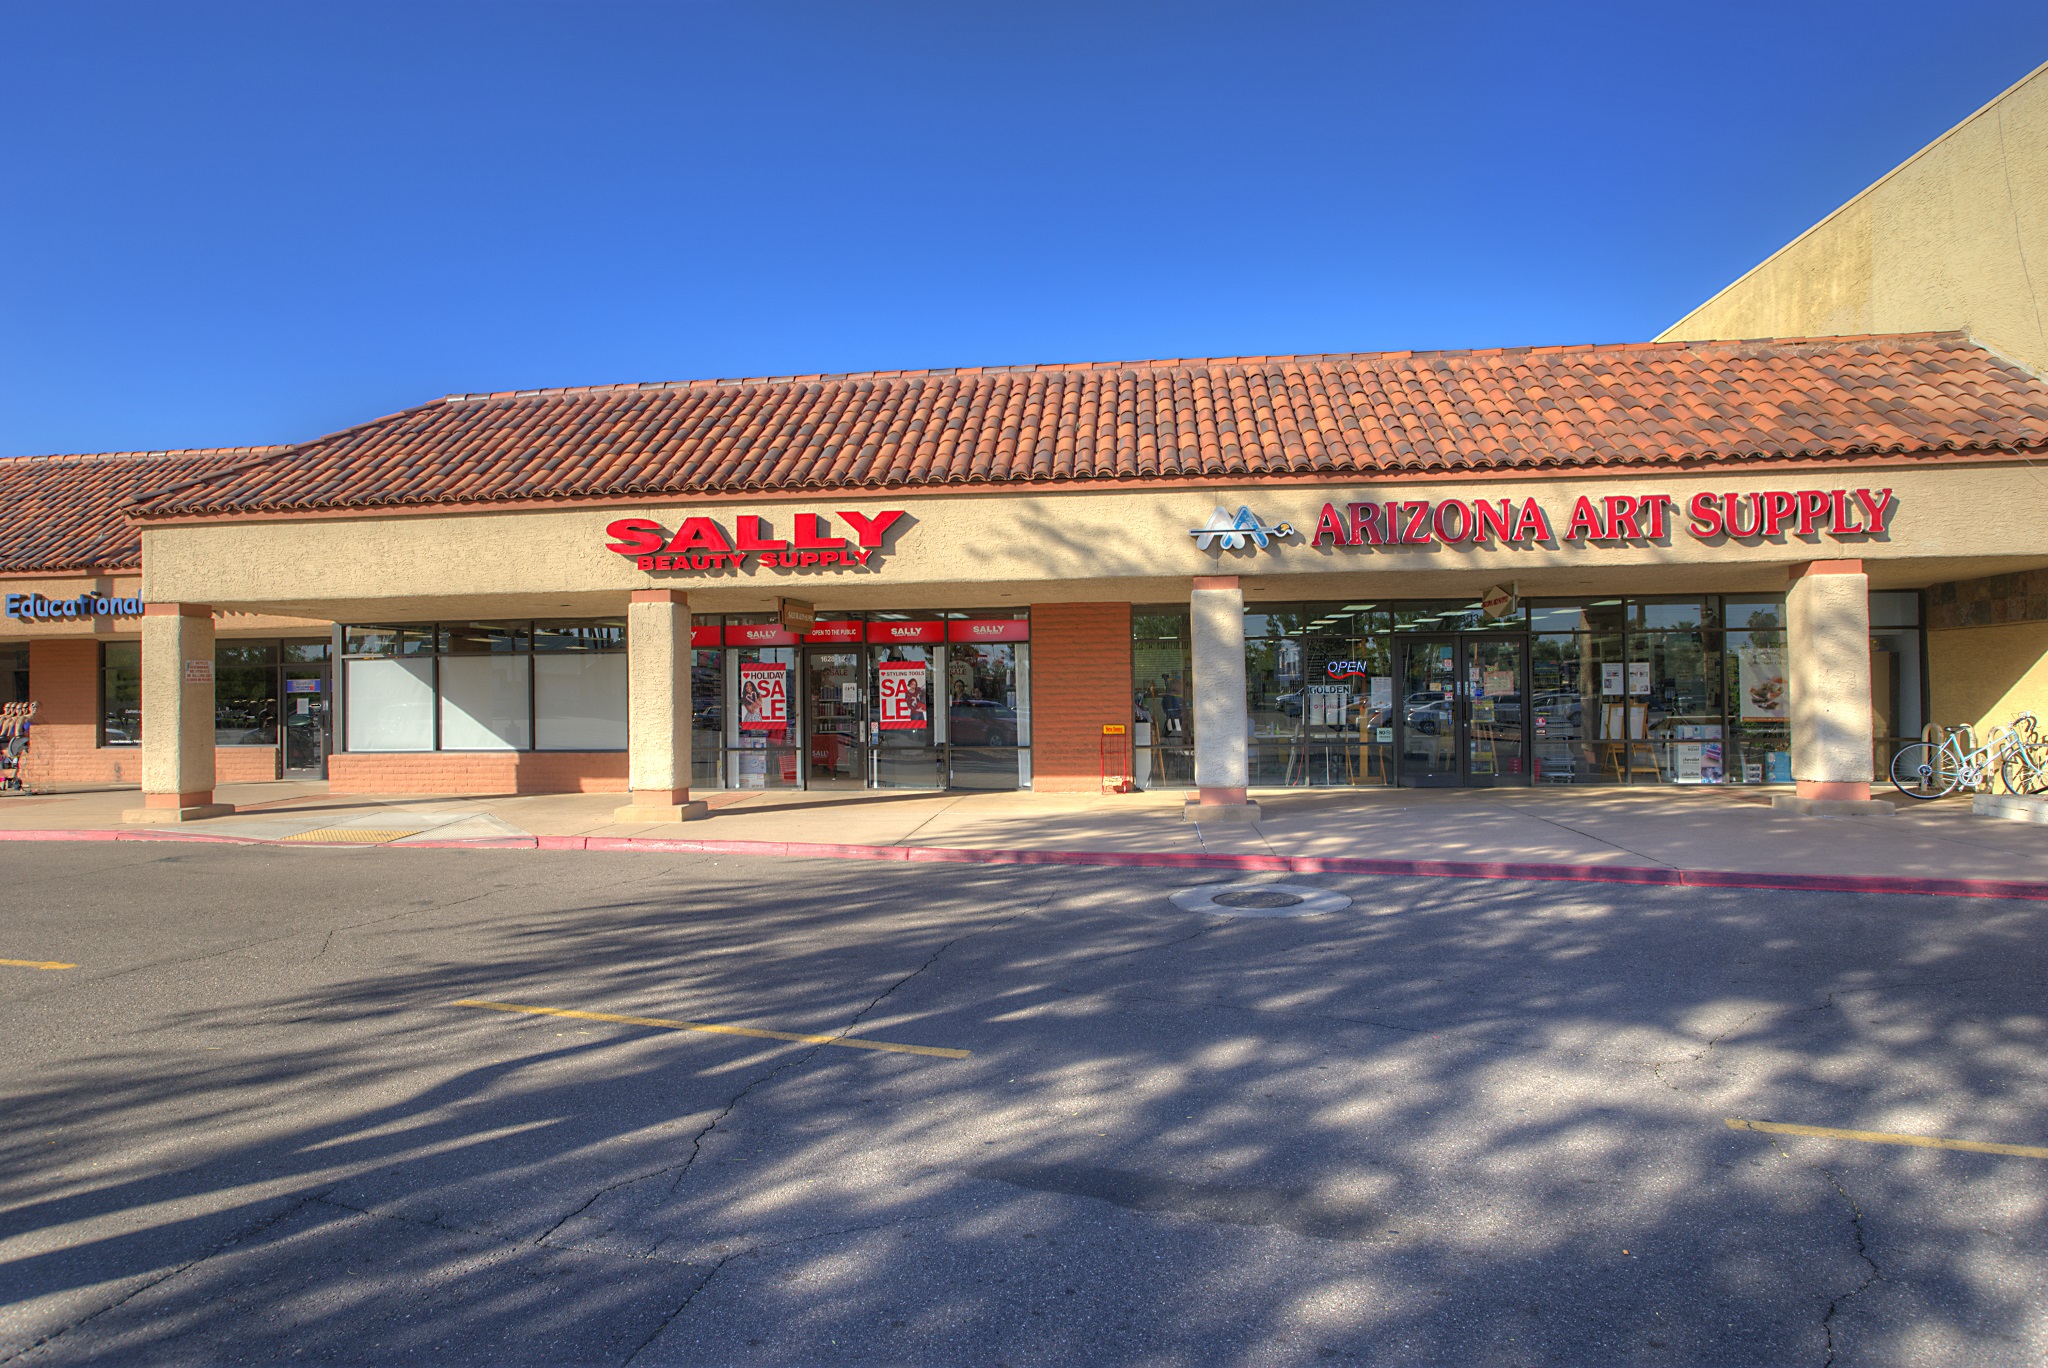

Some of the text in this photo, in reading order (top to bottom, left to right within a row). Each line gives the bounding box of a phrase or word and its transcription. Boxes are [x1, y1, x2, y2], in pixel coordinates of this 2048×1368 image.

[1311, 488, 1894, 547] ARIZONA ART SUPPLY
[605, 510, 906, 555] SALLY
[637, 550, 873, 571] BEAUTY SUPPLY
[5, 588, 144, 619] Educational
[747, 630, 777, 638] SALLY
[891, 627, 922, 635] SALLY
[973, 625, 1004, 633] SALLY
[1328, 661, 1367, 673] OPEN
[1309, 685, 1350, 694] GOLDEN
